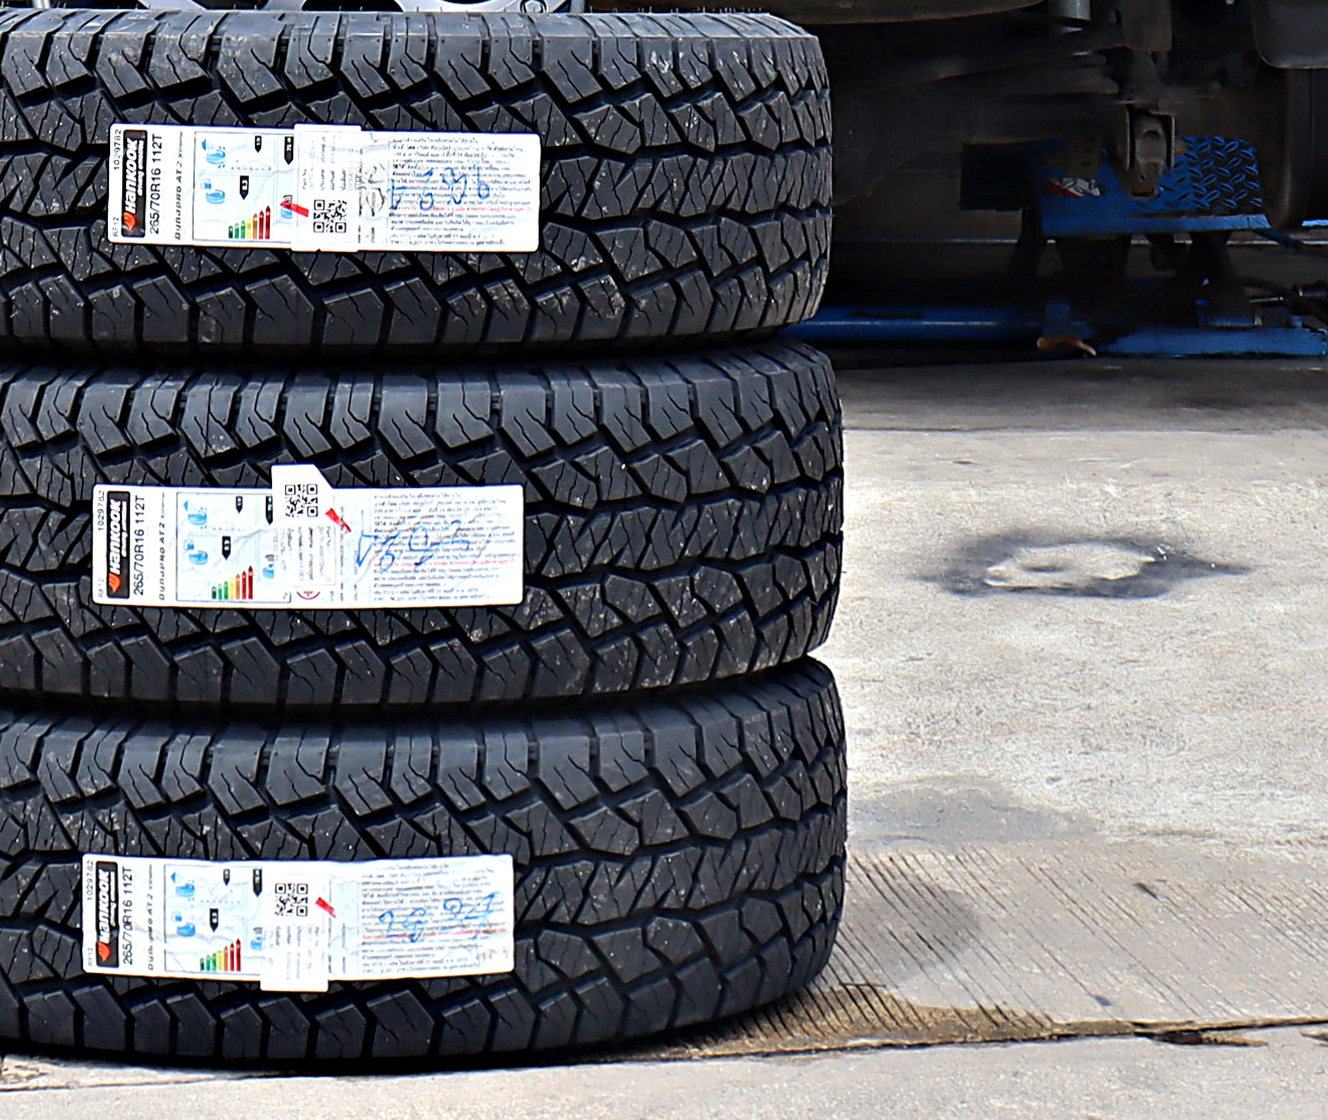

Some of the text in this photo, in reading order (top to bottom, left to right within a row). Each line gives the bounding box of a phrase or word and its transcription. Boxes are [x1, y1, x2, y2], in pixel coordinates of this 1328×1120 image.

[149, 133, 162, 235] 265/70R16 112T
[133, 494, 145, 596] 265/70R16 112T
[122, 865, 133, 965] 265/70R16 112T
